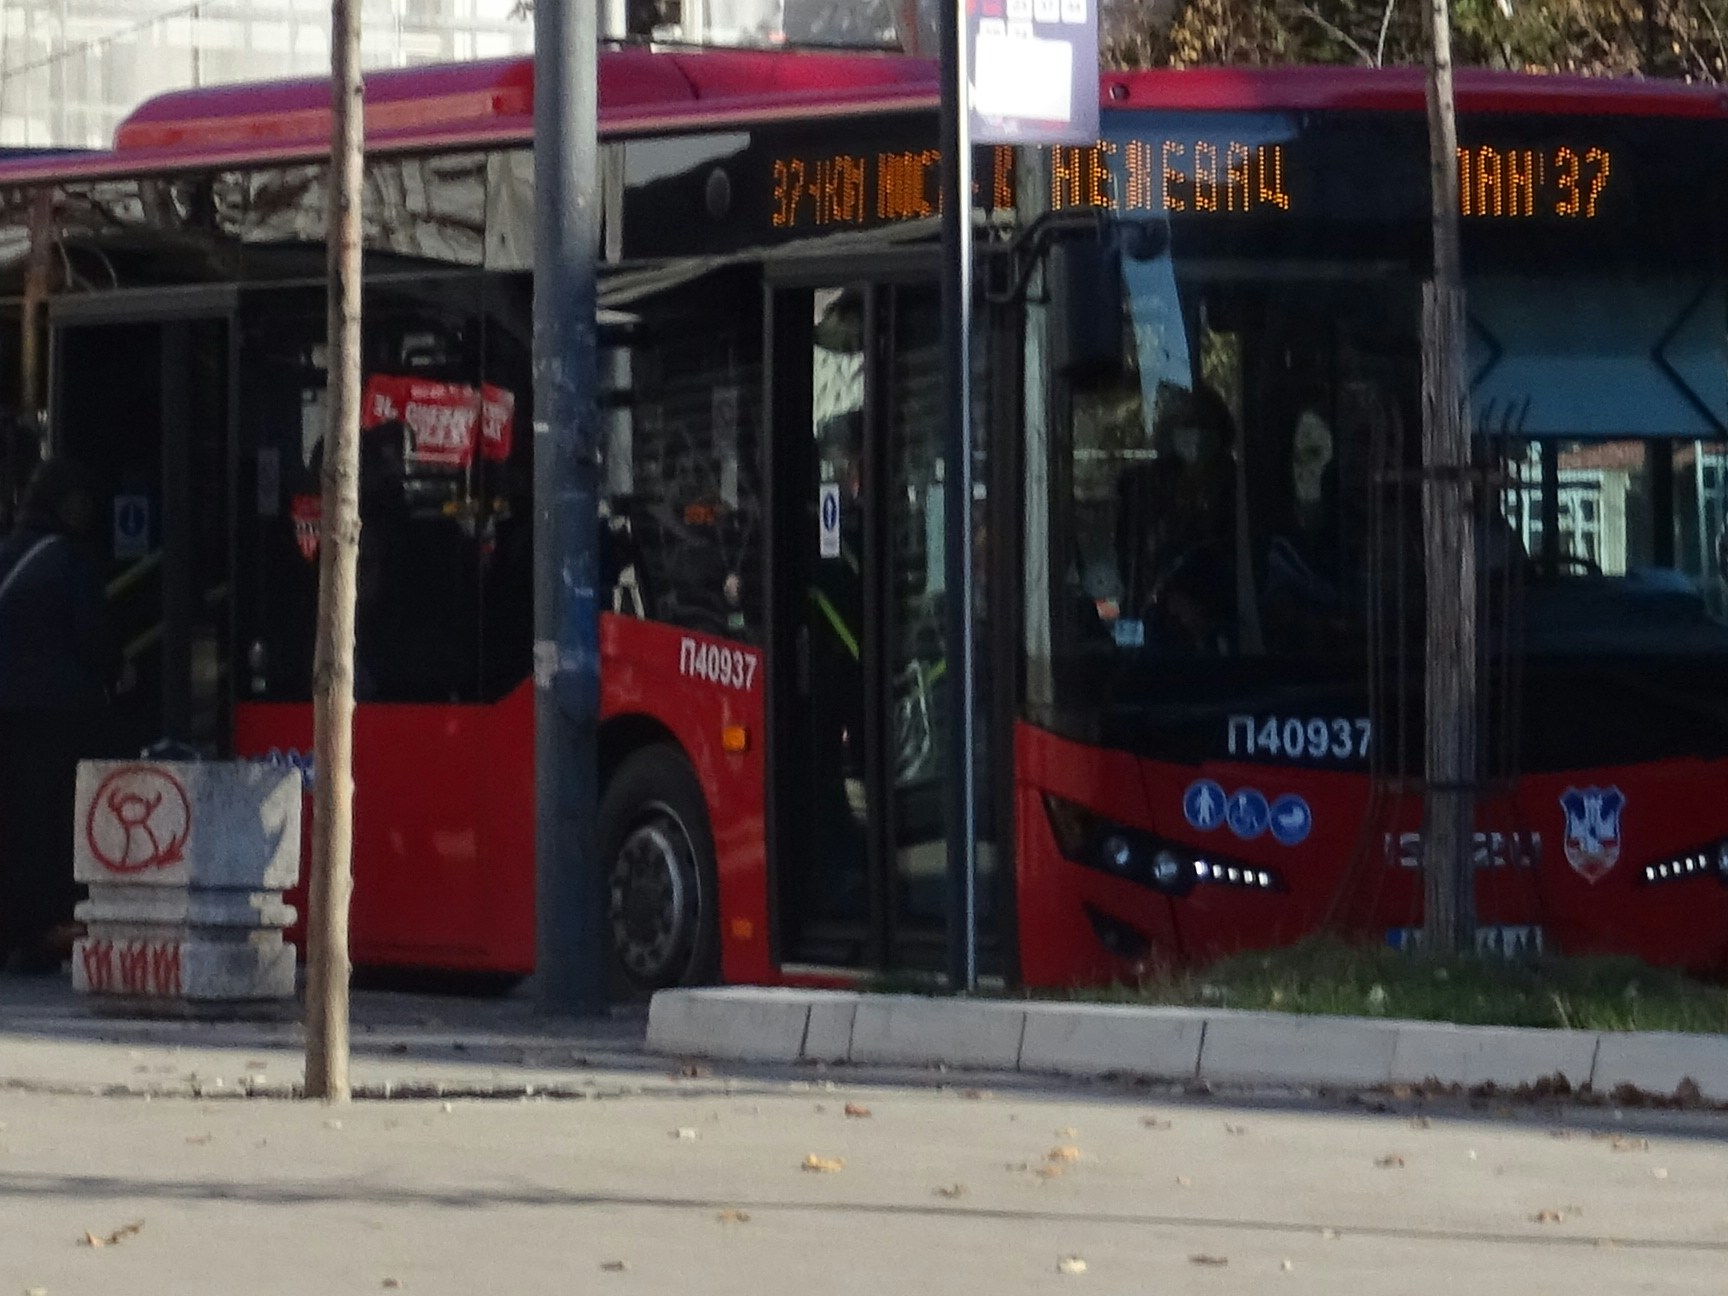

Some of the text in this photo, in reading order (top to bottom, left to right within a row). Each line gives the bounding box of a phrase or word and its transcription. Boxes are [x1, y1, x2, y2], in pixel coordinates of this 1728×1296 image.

[1554, 145, 1612, 218] 37
[679, 636, 758, 692] П40937
[1227, 713, 1372, 760] П40937
